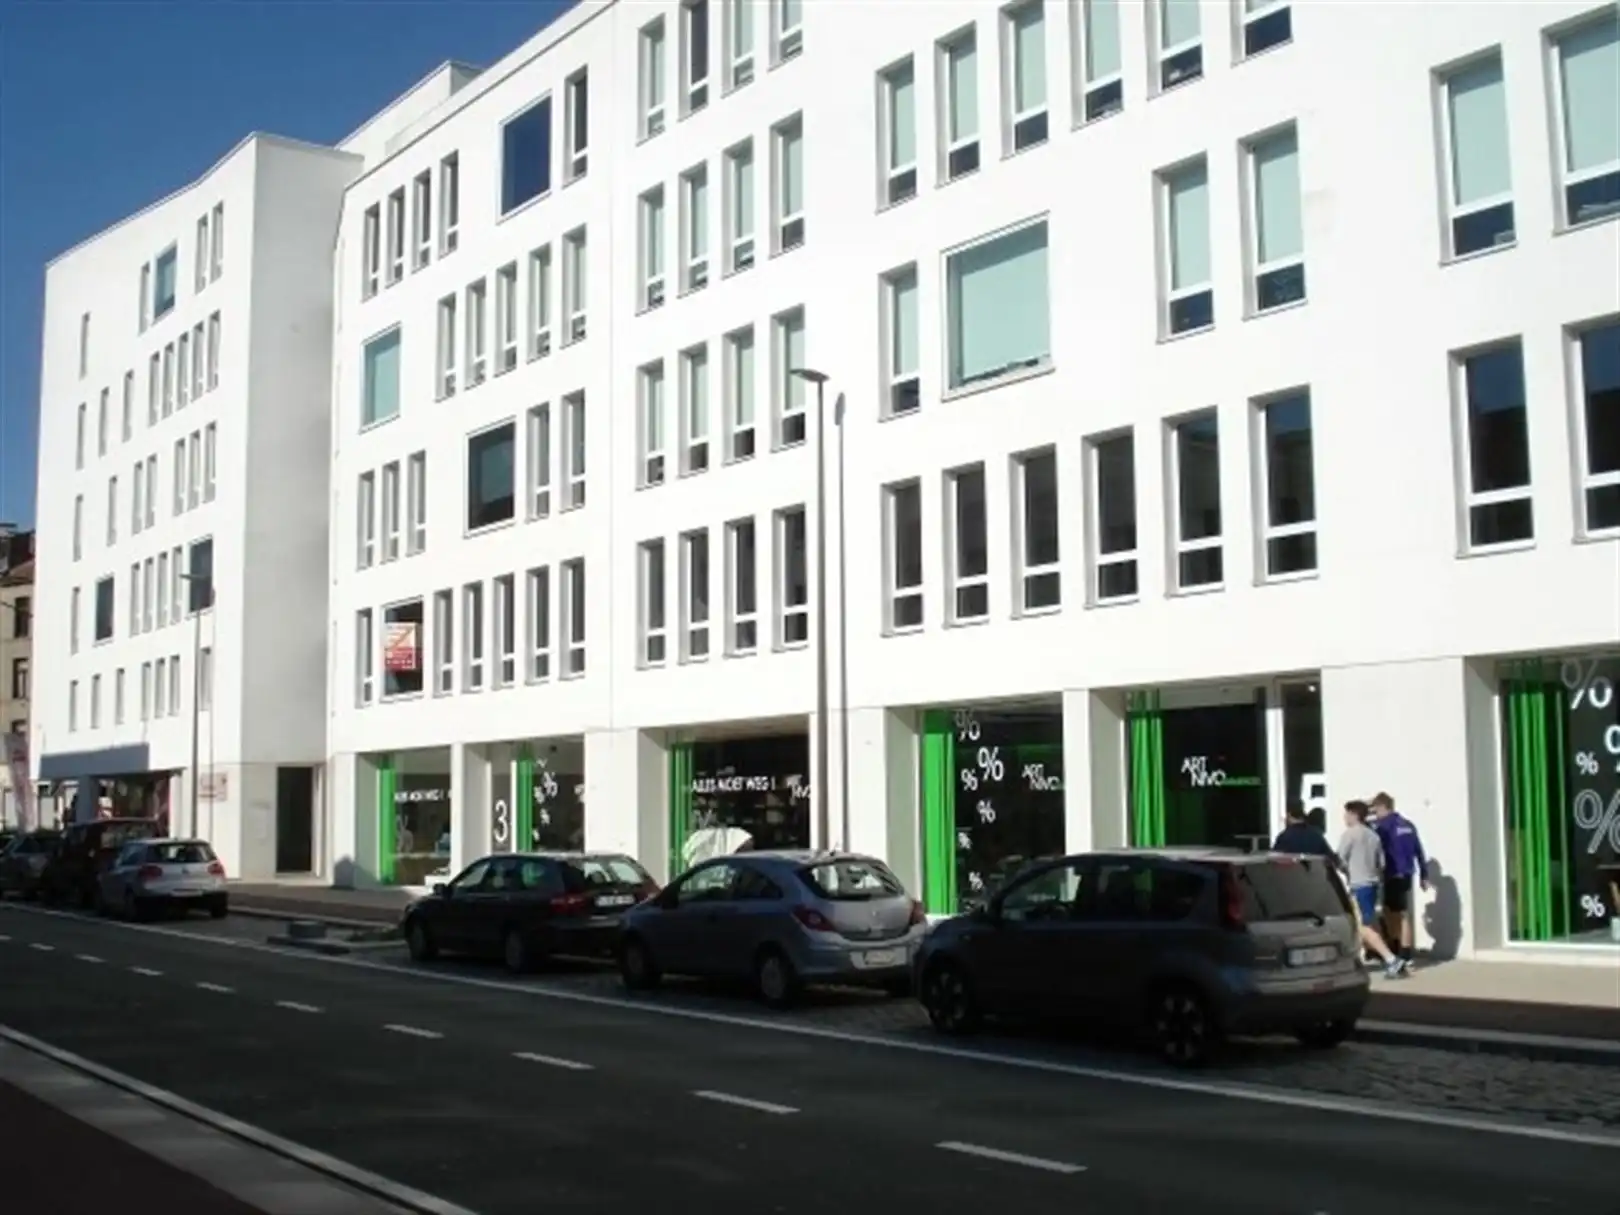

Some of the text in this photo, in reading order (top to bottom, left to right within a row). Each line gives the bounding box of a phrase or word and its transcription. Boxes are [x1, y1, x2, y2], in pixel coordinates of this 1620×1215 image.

[978, 746, 1004, 781] %
[1181, 755, 1208, 774] ART
[1575, 752, 1600, 775] %
[961, 768, 979, 791] %
[494, 799, 509, 843] 3
[1580, 895, 1606, 918] %
